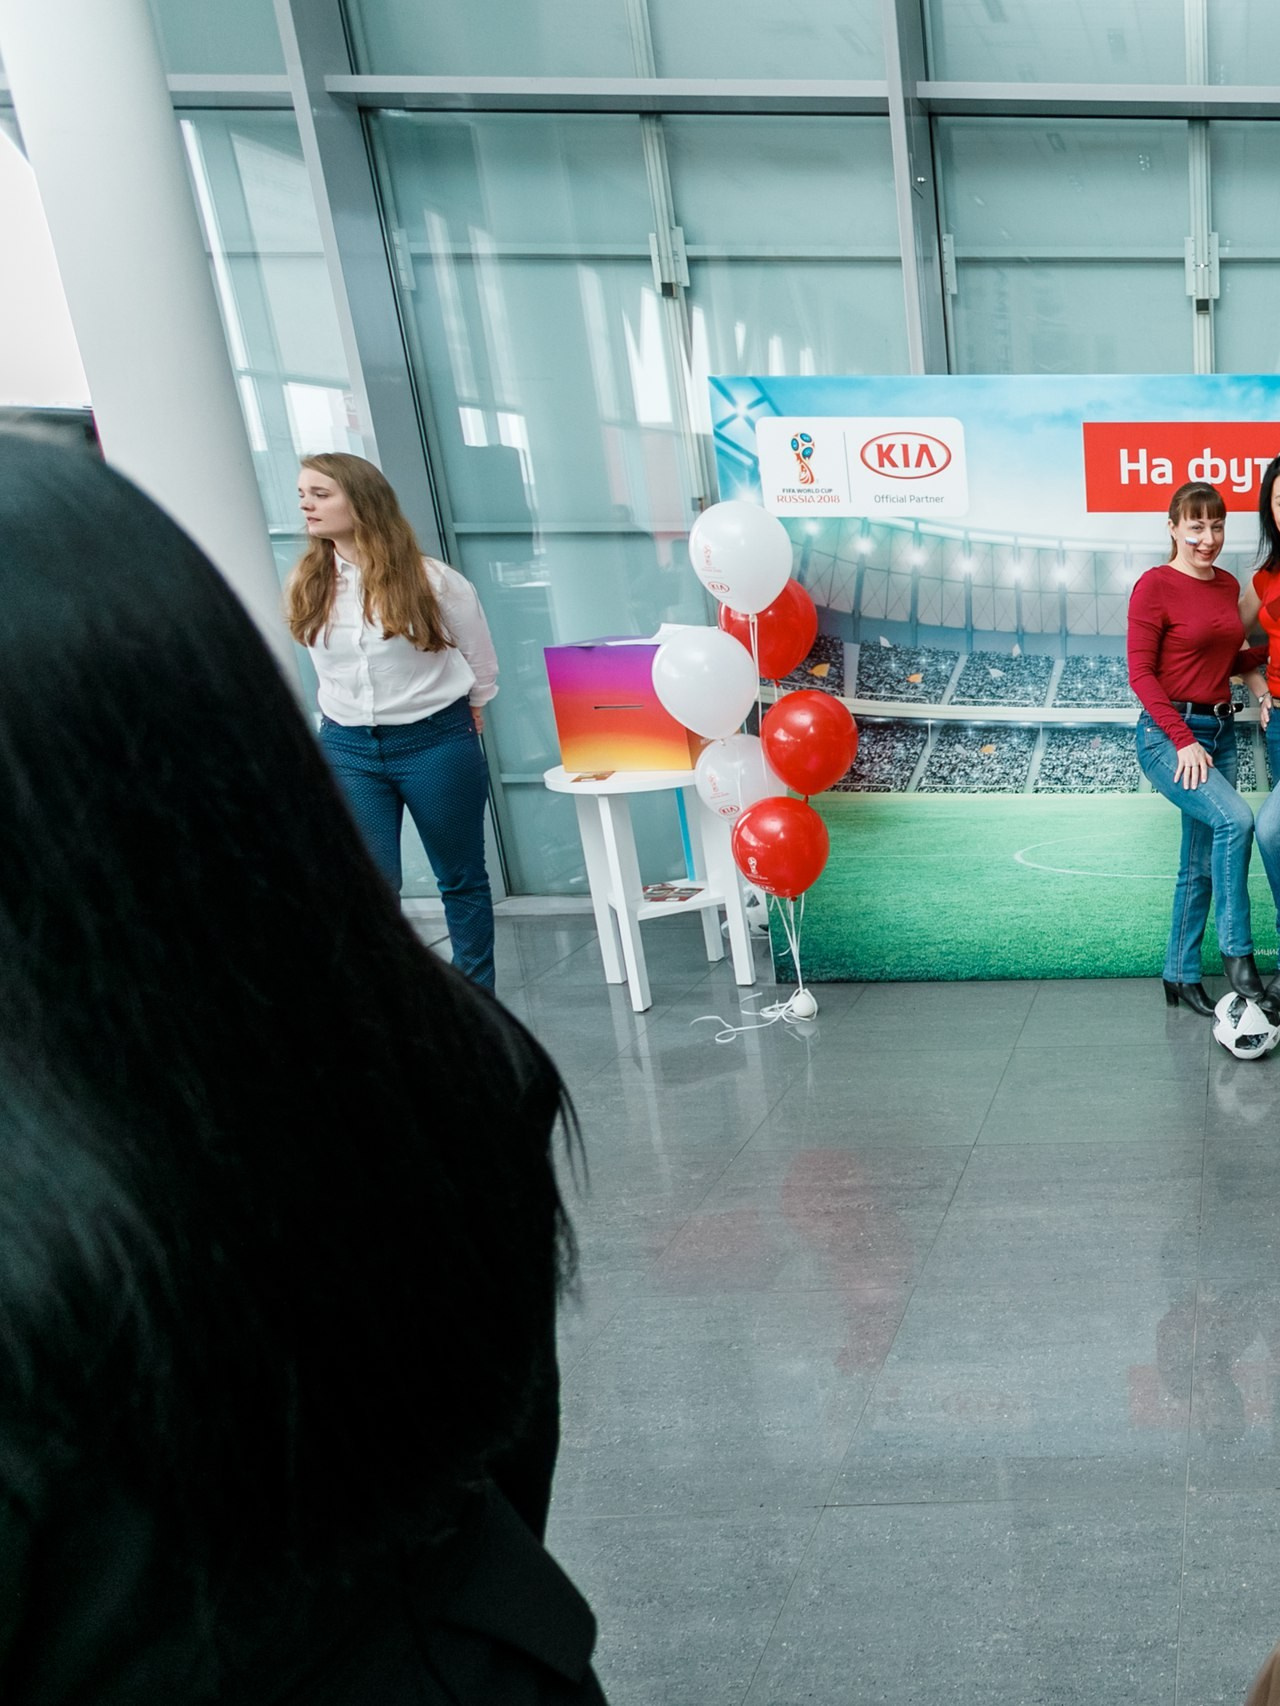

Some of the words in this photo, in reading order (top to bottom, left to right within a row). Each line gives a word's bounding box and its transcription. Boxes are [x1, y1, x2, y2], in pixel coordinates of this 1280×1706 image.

[875, 443, 937, 468] KIA
[1119, 448, 1173, 485] На
[776, 494, 815, 503] RUSSIA
[817, 494, 841, 503] 2018
[873, 494, 907, 504] Official
[909, 494, 945, 504] Partner
